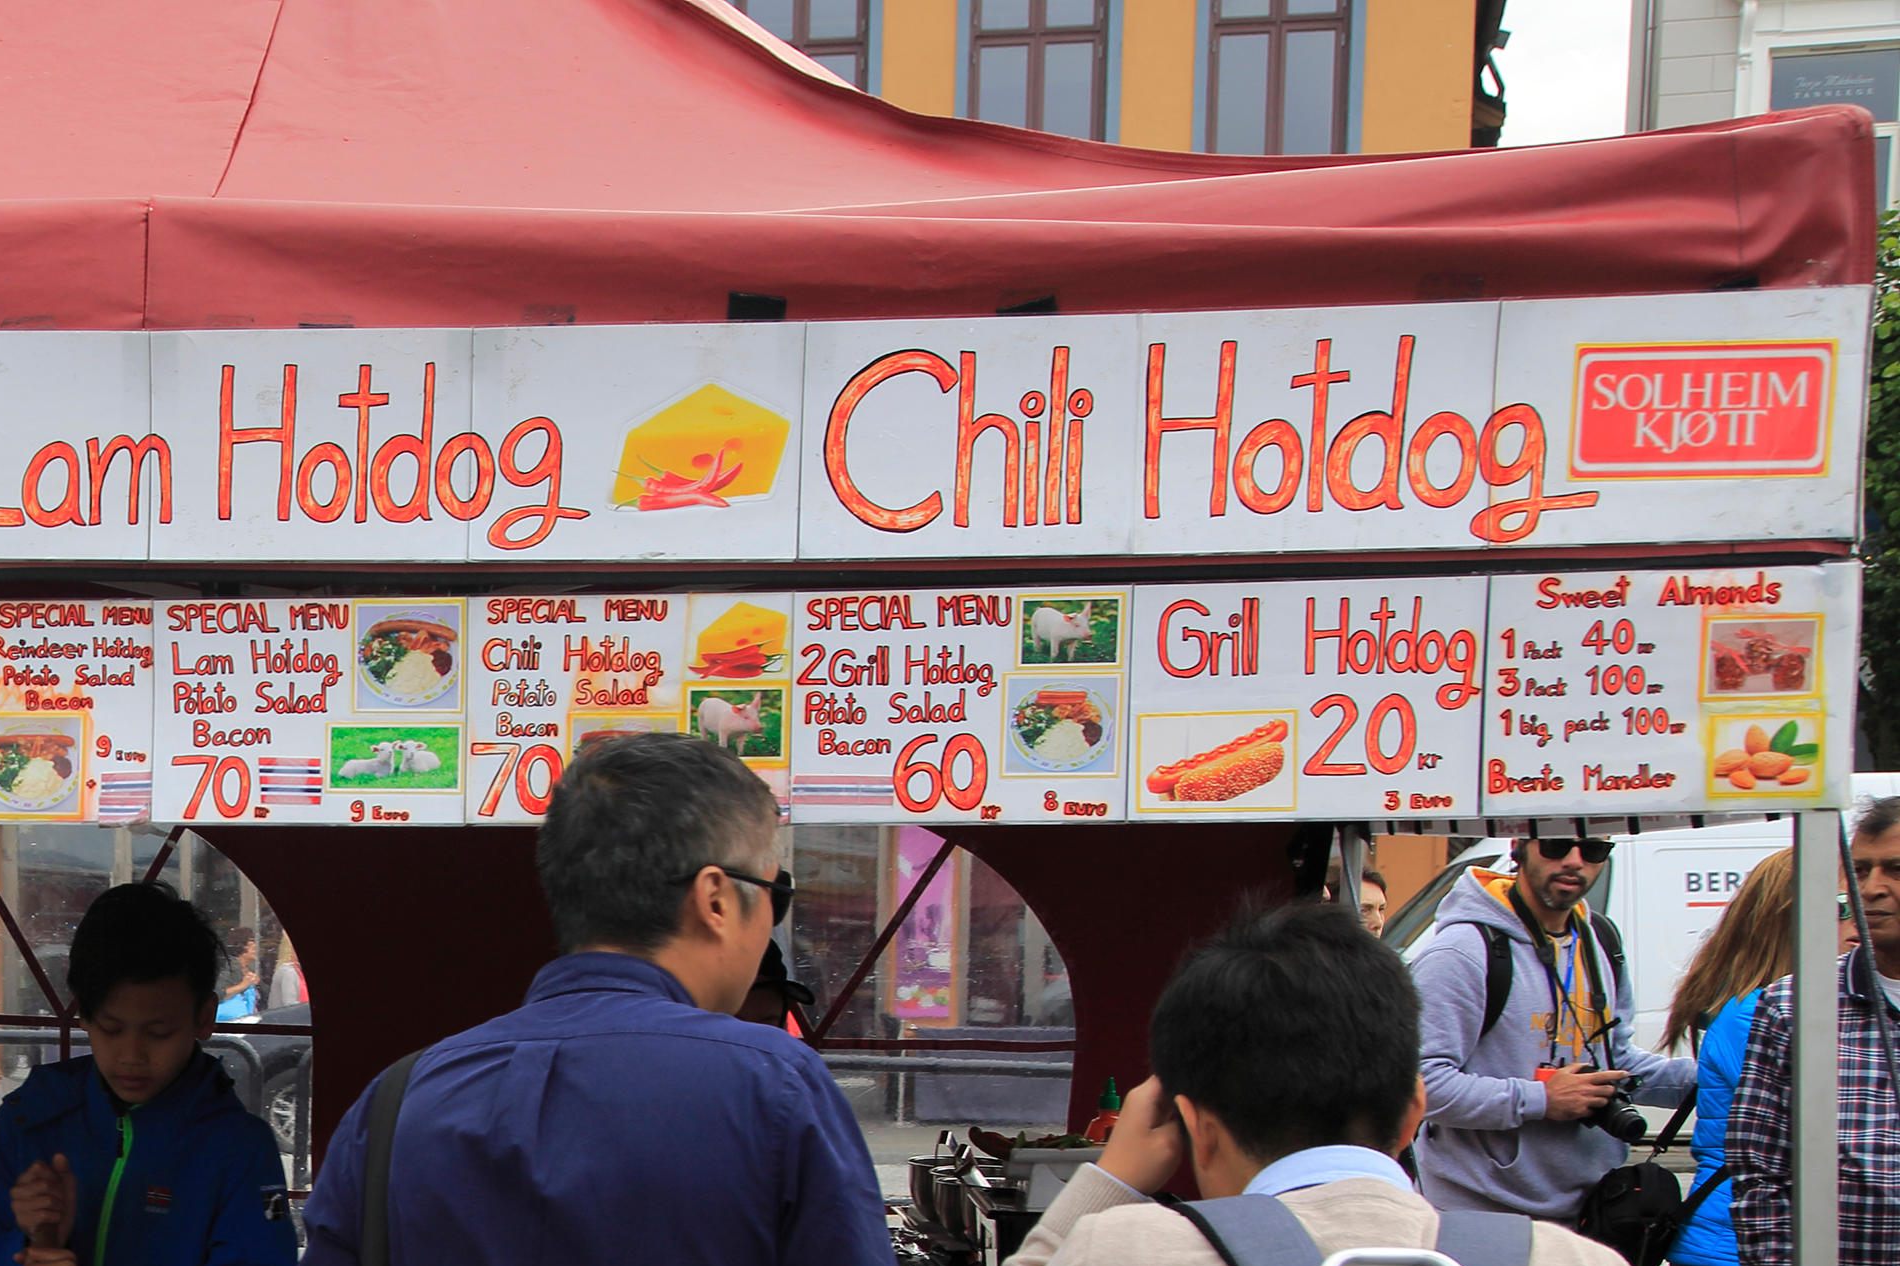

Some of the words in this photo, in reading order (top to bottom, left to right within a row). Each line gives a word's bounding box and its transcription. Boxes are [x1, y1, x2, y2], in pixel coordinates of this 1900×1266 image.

[1591, 371, 1809, 411] SOLHEIM
[824, 346, 1093, 534] Chili
[1145, 335, 1599, 543] Hotdog
[1634, 409, 1768, 454] KJØTT
[218, 362, 590, 550] Hotdog
[1536, 576, 1630, 609] Sweet
[1657, 571, 1782, 606] Almonds
[102, 606, 153, 625] MENU
[167, 602, 279, 633] SPECIAL
[290, 604, 349, 630] MENU
[487, 599, 586, 624] SPECIAL
[604, 599, 668, 622] MENU
[806, 595, 927, 631] SPECIAL
[938, 594, 1012, 627] MENU
[93, 637, 154, 668] Hotdog
[1157, 597, 1259, 678] Grill
[1304, 595, 1481, 710] Hotdog
[1501, 627, 1516, 659] 1
[1523, 641, 1562, 660] Pack
[1581, 618, 1636, 656] 40
[3, 665, 60, 686] Potato
[74, 664, 135, 687] Salad
[171, 642, 234, 675] Lam
[250, 639, 342, 687] Hotdog
[481, 635, 542, 672] Chili
[563, 634, 664, 687] Hotdog
[905, 645, 997, 697] Hotdog
[173, 682, 237, 714] Potato
[255, 681, 327, 714] Salad
[491, 679, 557, 707] Potato
[575, 679, 649, 705] Salad
[1497, 667, 1520, 696] 3
[1525, 677, 1568, 697] Pack
[1585, 664, 1646, 696] 100
[25, 690, 93, 711] Bacon
[805, 691, 867, 725] Potato
[889, 689, 967, 724] Salad
[193, 719, 271, 747] Bacon
[495, 712, 558, 737] Bacon
[818, 729, 891, 756] Bacon
[1303, 693, 1417, 776] 20
[1499, 708, 1512, 736] 1
[1519, 714, 1553, 747] big
[1564, 712, 1610, 742] pack
[1622, 707, 1669, 735] 100
[95, 735, 112, 757] 9
[115, 750, 146, 763] Euro
[171, 755, 252, 819] 70
[471, 742, 564, 817] 70
[893, 732, 988, 813] 60
[1487, 758, 1565, 794] Brente
[1583, 763, 1677, 792] Mandler
[350, 800, 365, 822] 9
[372, 806, 409, 821] Euro
[1043, 790, 1058, 811] 8
[1064, 802, 1108, 816] Euro
[1384, 791, 1400, 811] 3
[1410, 793, 1453, 809] Euro
[1685, 871, 1751, 892] BER
